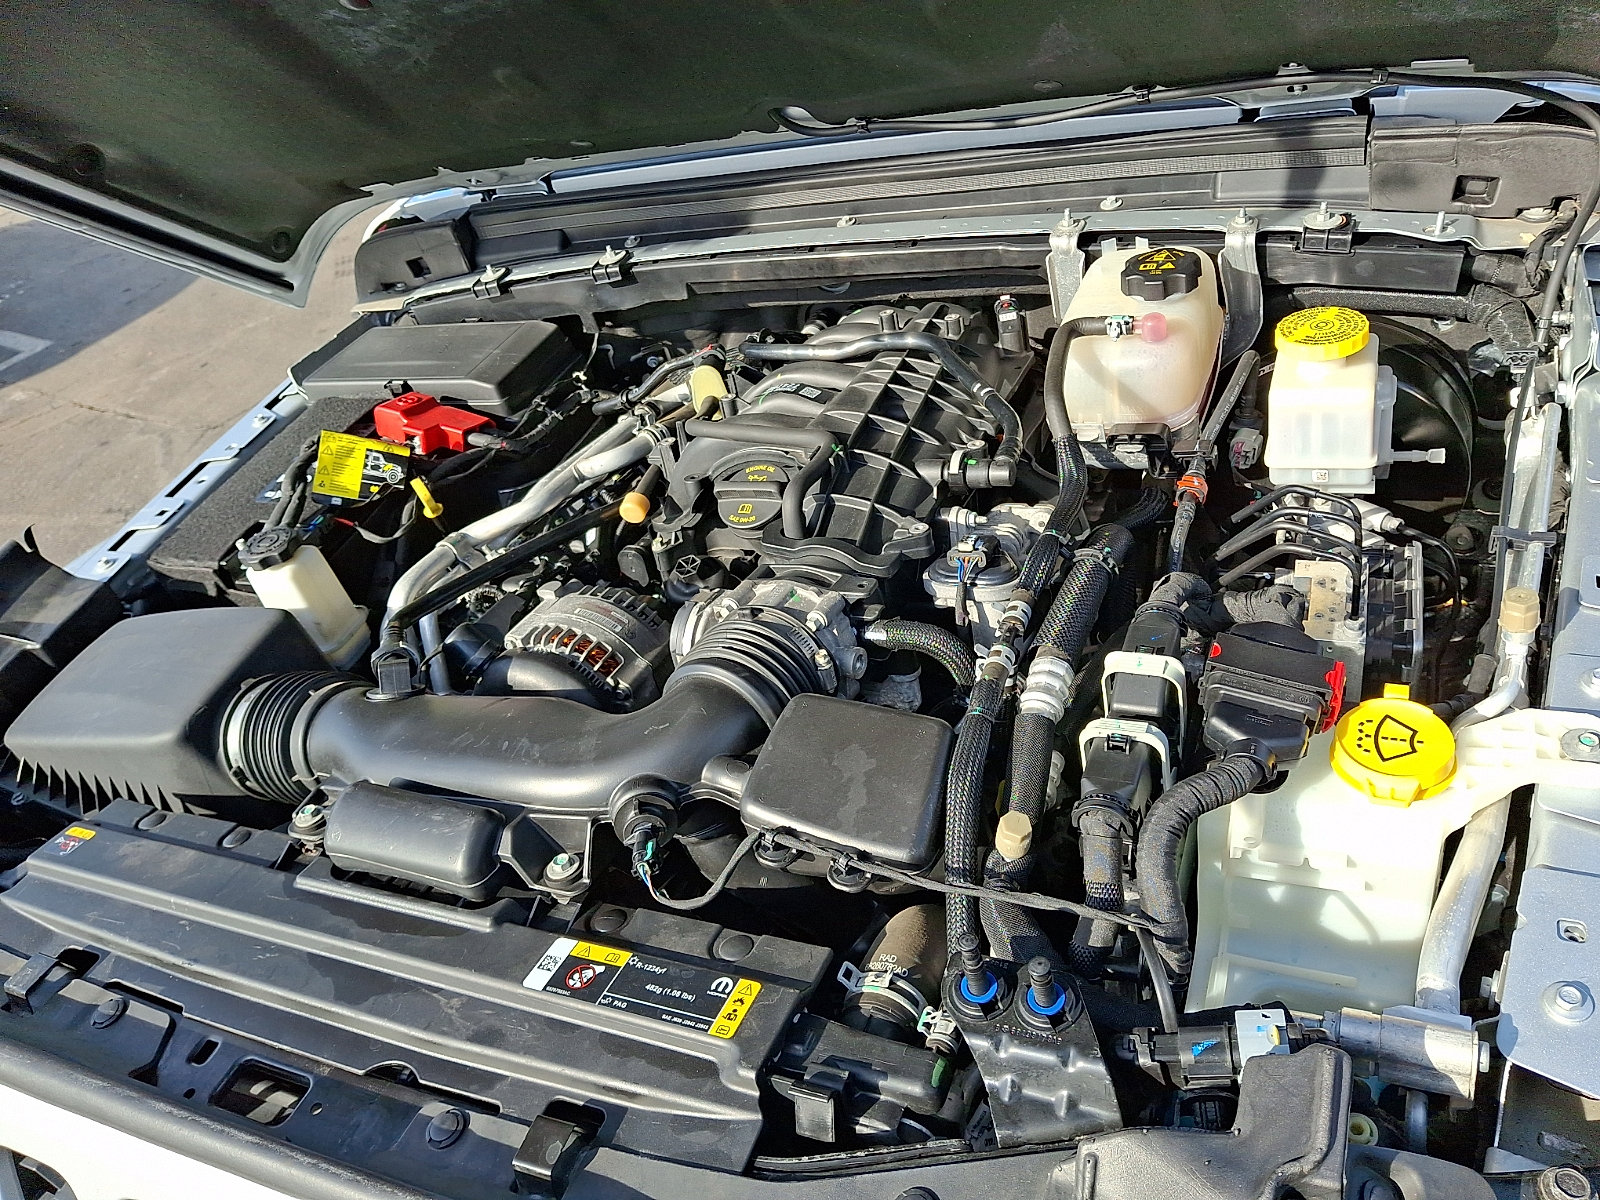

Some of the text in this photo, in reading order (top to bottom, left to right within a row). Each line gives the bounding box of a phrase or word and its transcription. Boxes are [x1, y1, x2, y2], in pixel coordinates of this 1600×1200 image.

[878, 953, 898, 963] RAD
[635, 962, 668, 975] R-1234yf
[612, 999, 628, 1009] PAG
